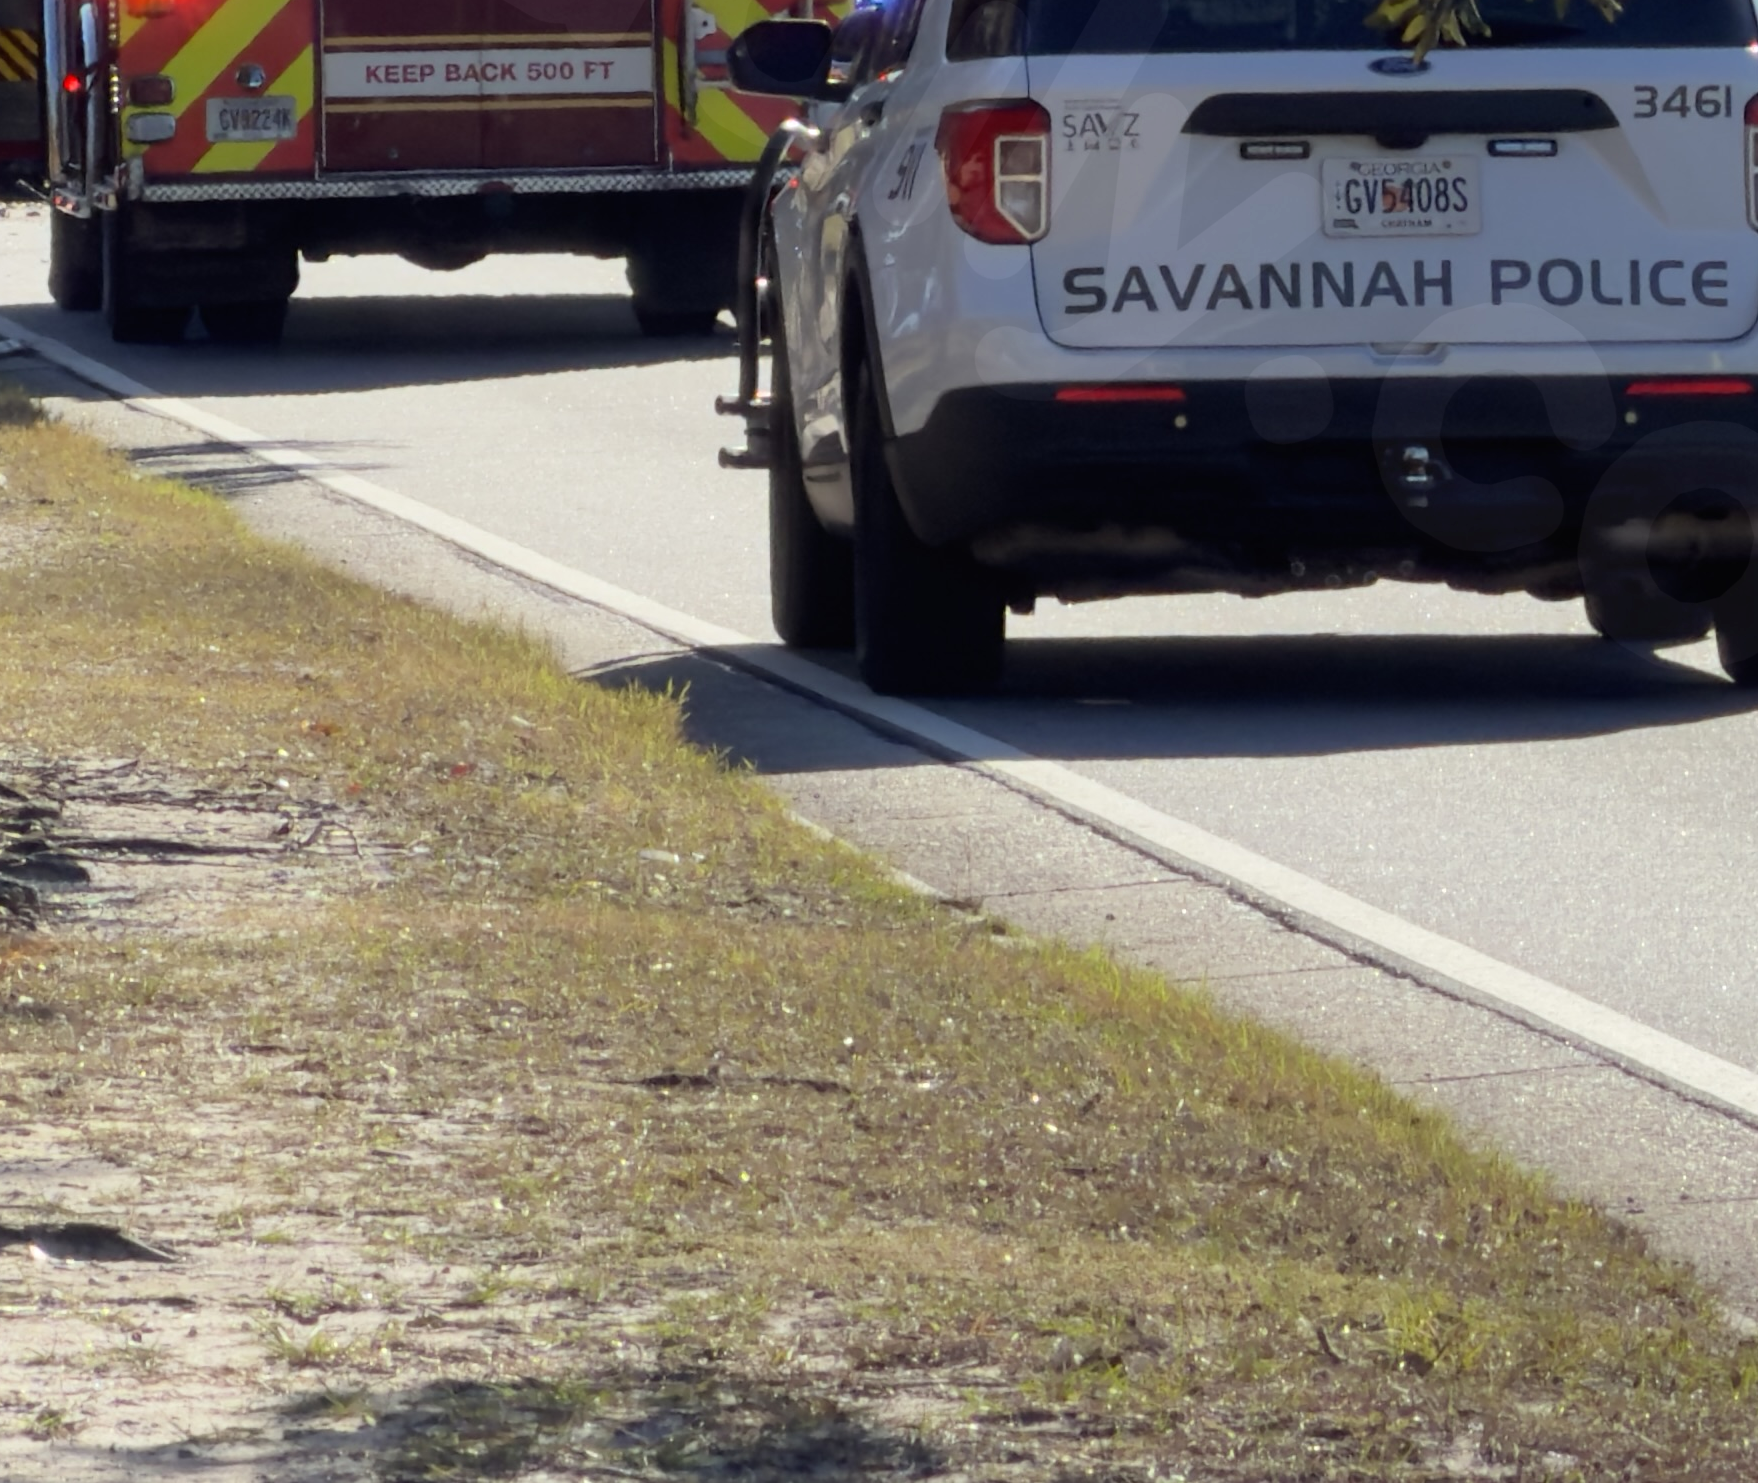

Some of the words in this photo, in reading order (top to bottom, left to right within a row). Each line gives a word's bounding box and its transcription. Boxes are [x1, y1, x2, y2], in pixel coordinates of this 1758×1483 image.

[365, 64, 436, 84] KEEP
[445, 62, 517, 83] BACK
[527, 62, 574, 81] 500
[583, 60, 616, 80] FT
[1633, 84, 1732, 119] 3461
[1357, 161, 1442, 177] GEORGIA
[1345, 176, 1469, 215] GV5408S
[1062, 258, 1453, 315] SAVANNAH
[1489, 257, 1730, 308] POLICE
